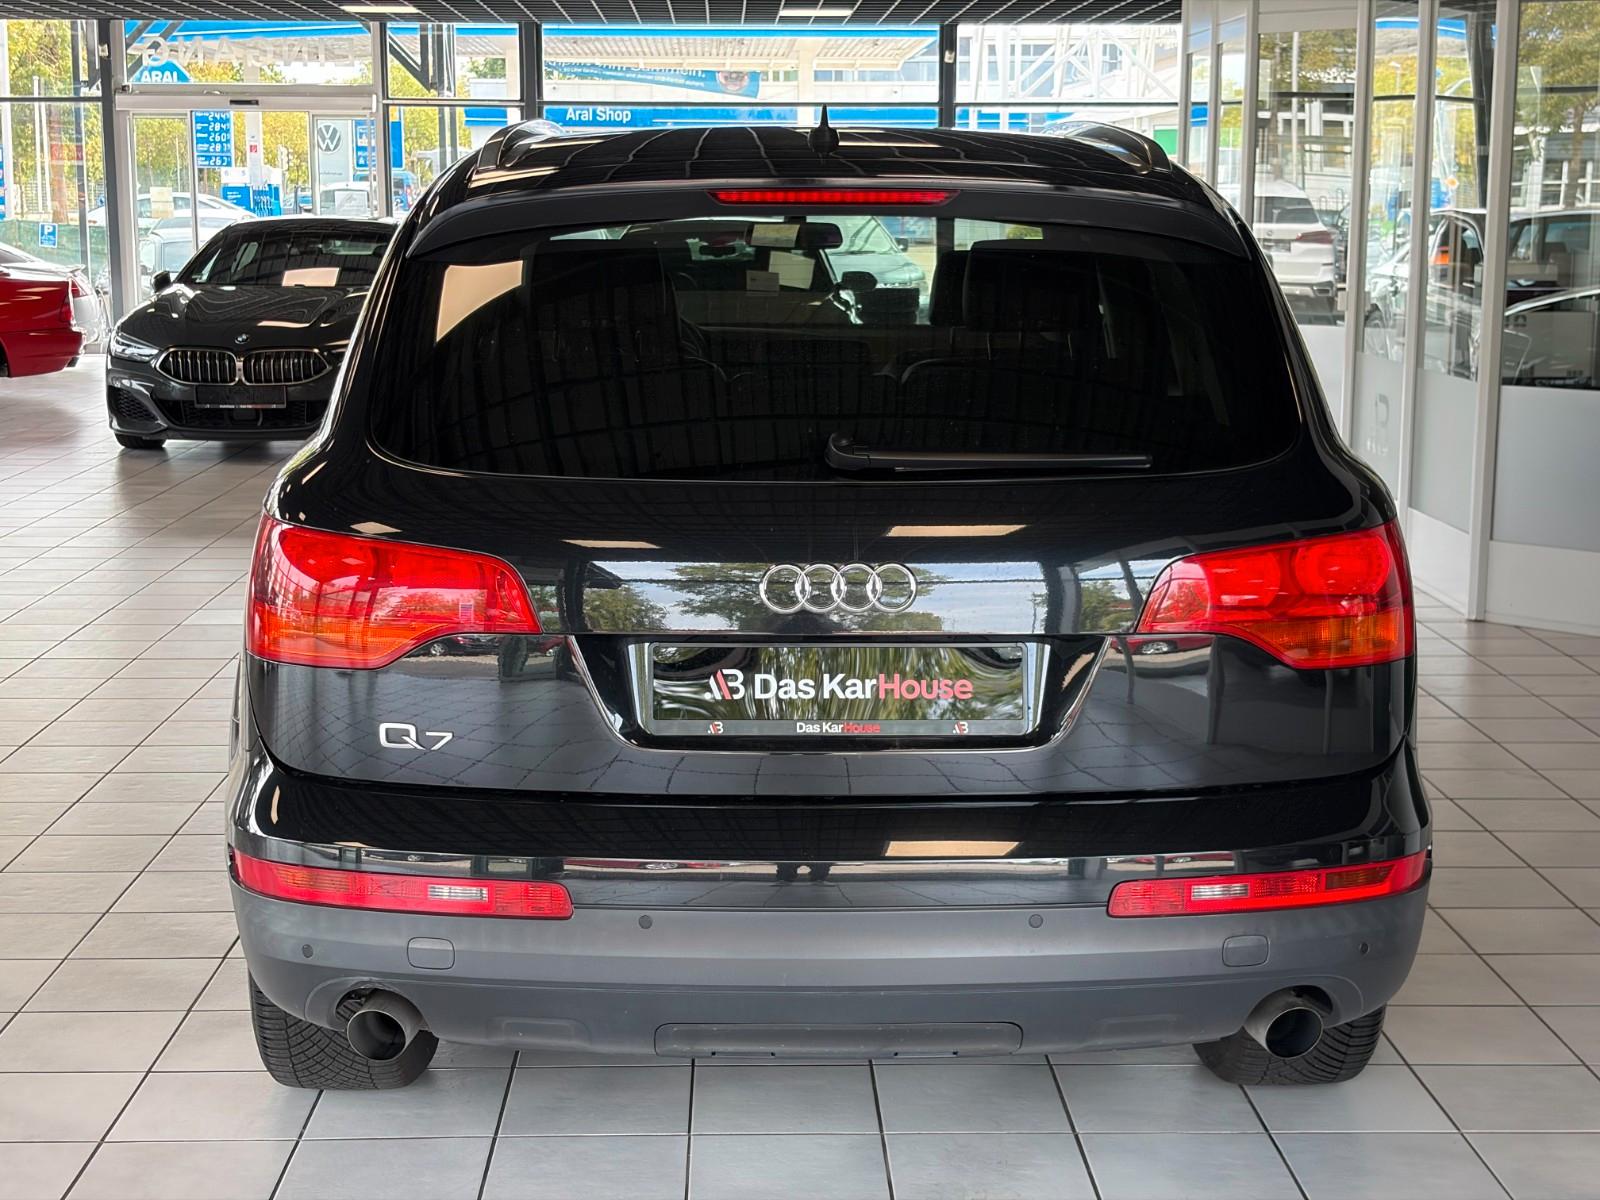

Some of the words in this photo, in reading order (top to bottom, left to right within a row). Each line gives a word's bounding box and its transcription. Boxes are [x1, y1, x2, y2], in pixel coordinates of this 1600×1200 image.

[565, 107, 593, 121] Aral
[596, 107, 632, 123] Shop
[44, 225, 53, 235] P
[754, 673, 816, 700] Das
[823, 673, 974, 700] KarHouse
[796, 721, 821, 733] Das
[822, 721, 881, 733] KarHouse
[379, 722, 454, 750] Q7
